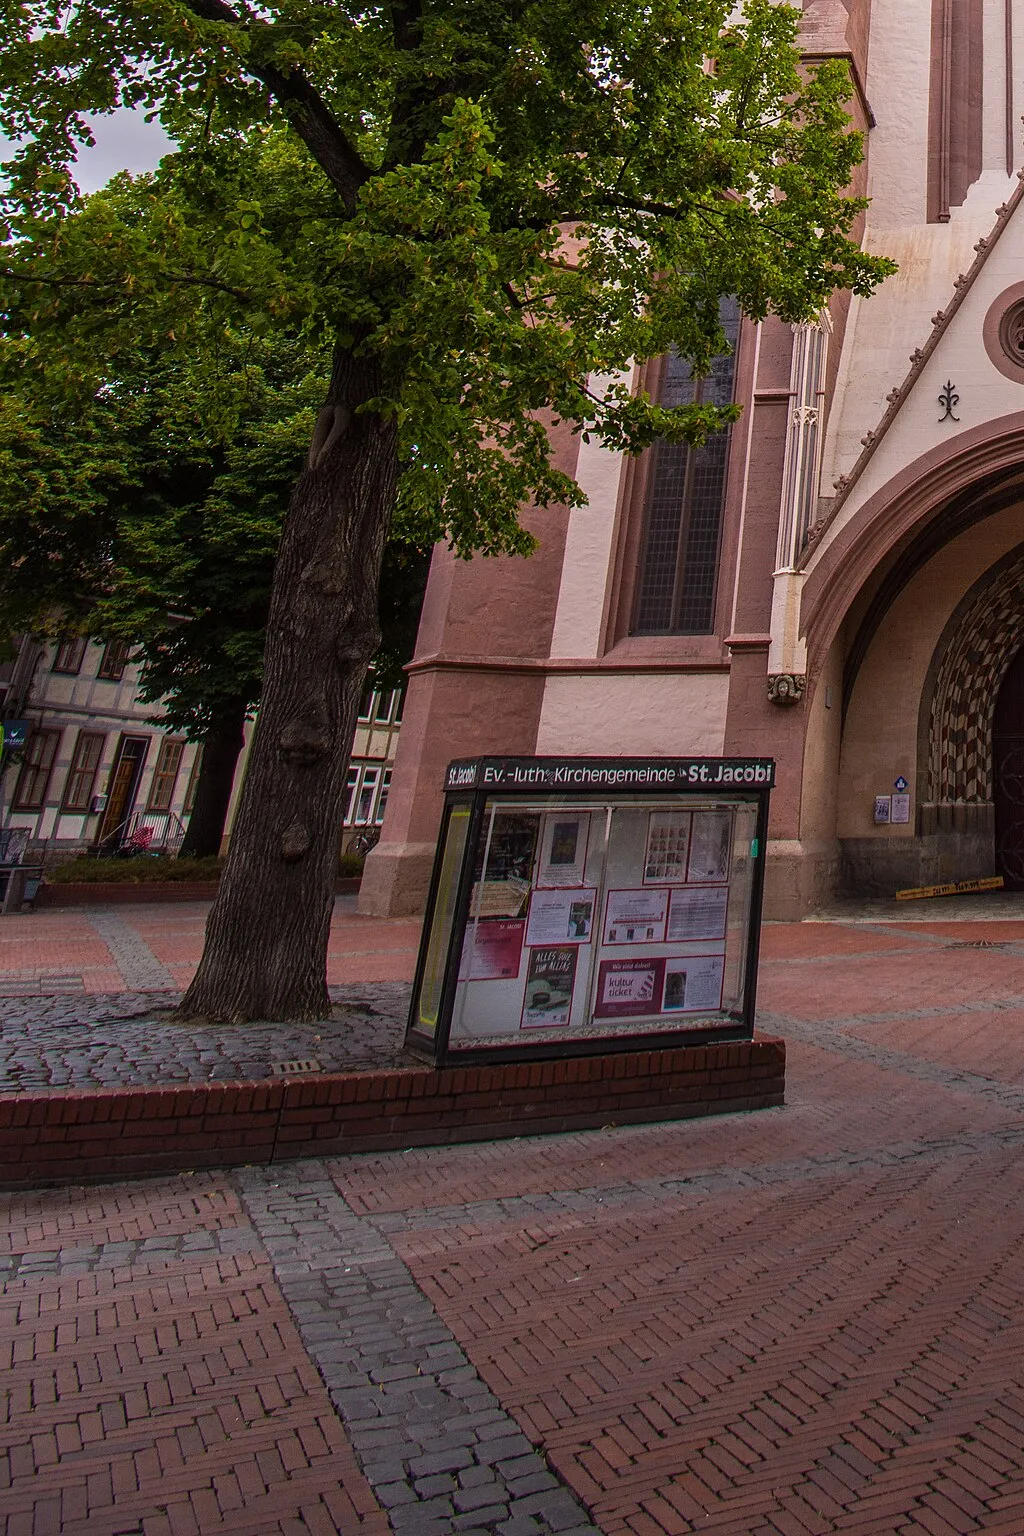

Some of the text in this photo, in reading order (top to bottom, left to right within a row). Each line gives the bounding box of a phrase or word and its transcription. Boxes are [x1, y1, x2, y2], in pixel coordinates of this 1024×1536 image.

[484, 766, 548, 782] Ev.-luth.
[554, 766, 676, 784] Kirchengemeinde
[536, 951, 557, 962] ALLES
[609, 976, 634, 987] kultur
[609, 987, 633, 997] ticket
